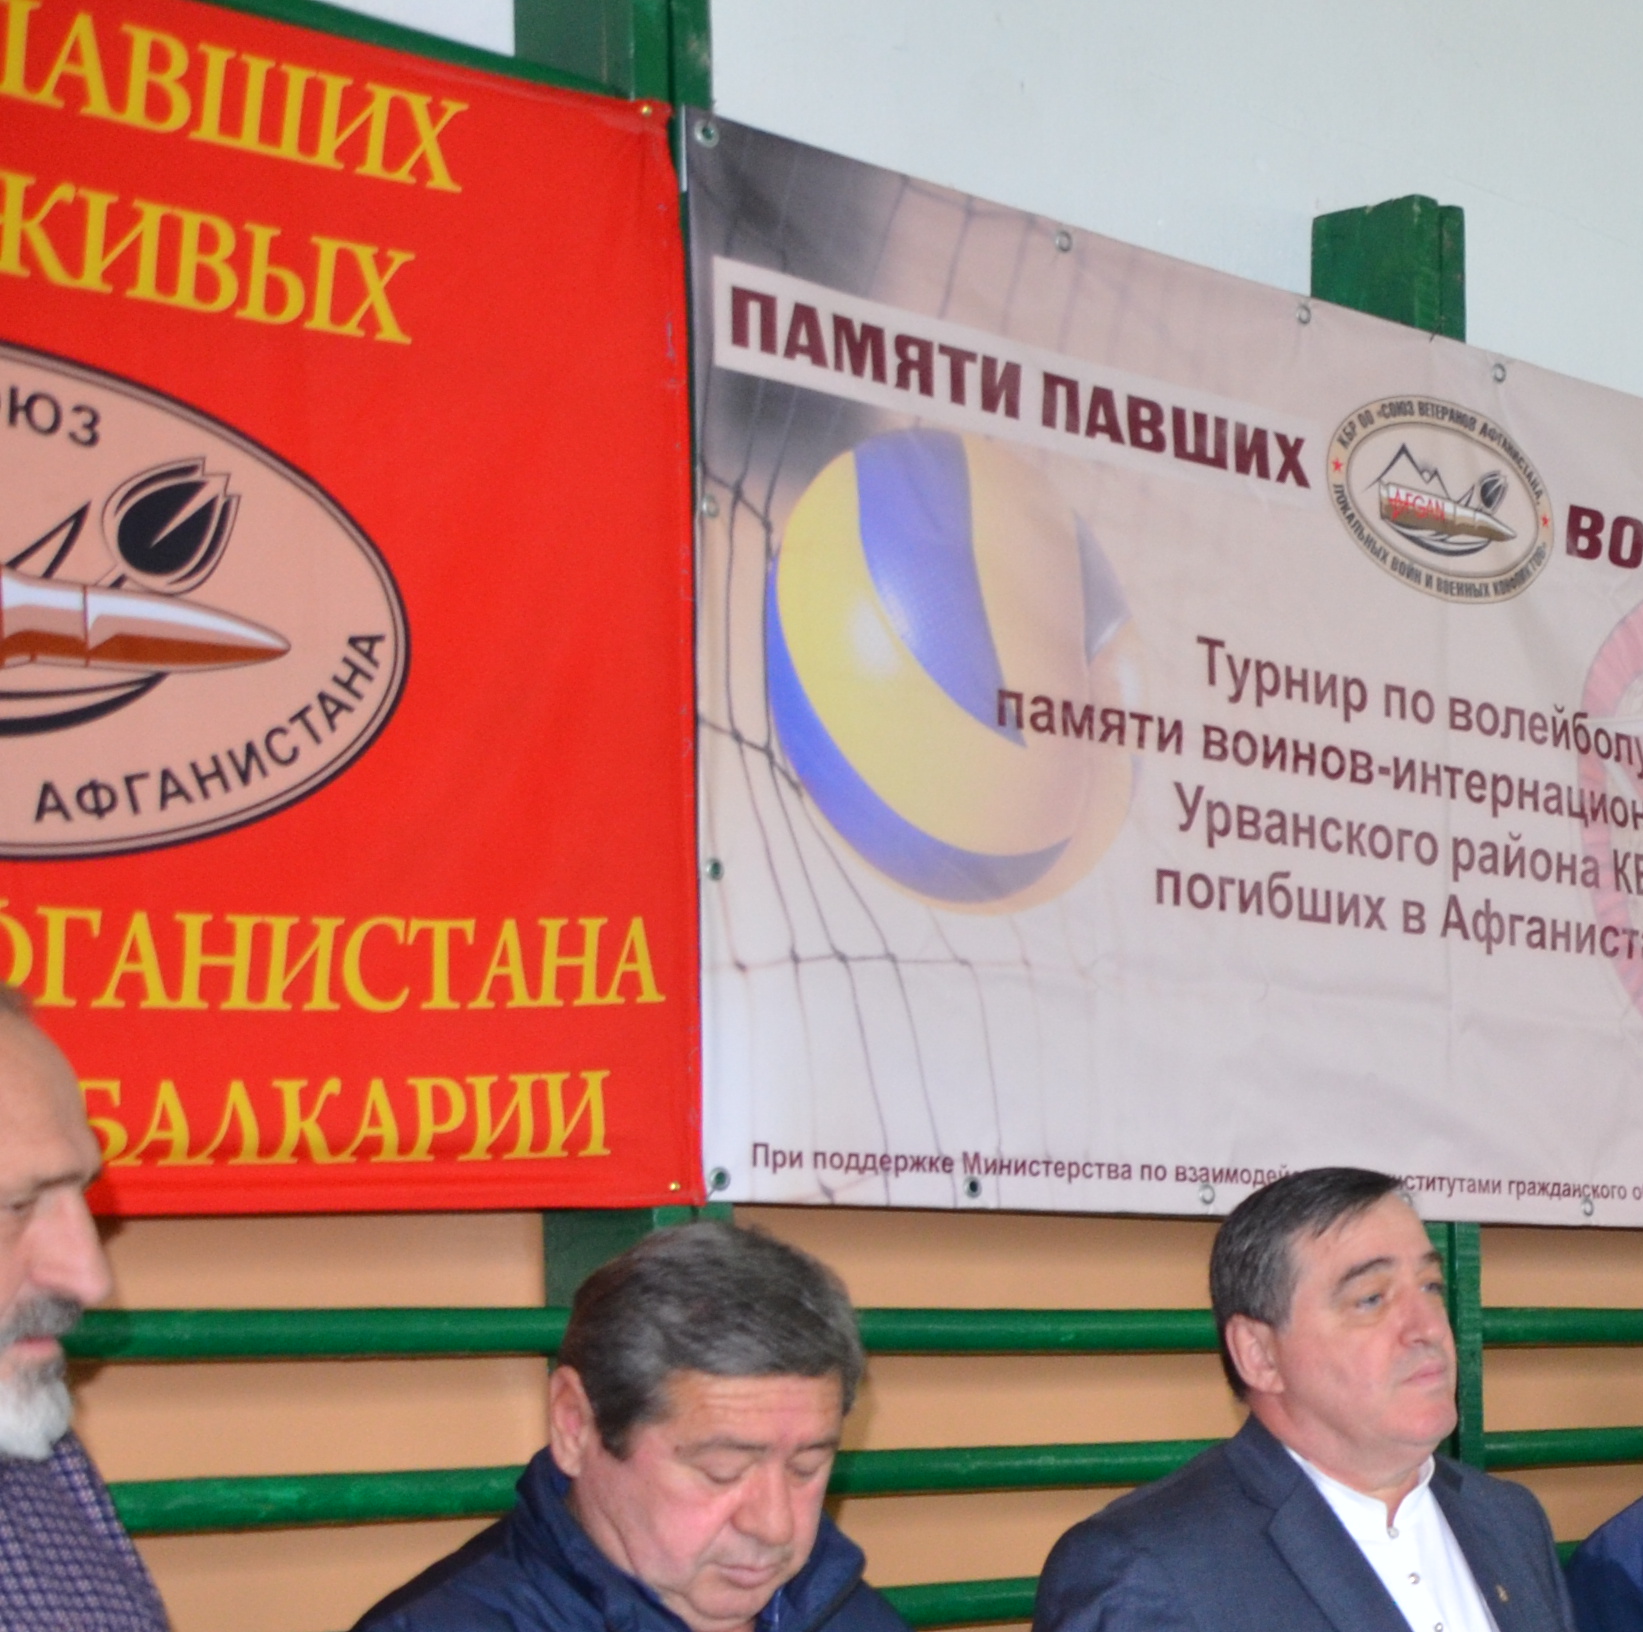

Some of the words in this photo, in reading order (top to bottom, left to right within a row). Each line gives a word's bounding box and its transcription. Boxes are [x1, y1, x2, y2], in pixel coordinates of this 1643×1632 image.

[0, 385, 102, 449] ЮЗ
[731, 285, 1022, 420] ПАМЯТИ
[1041, 371, 1311, 489] ПАВШИХ
[1333, 484, 1389, 564] ЛОКАЛЬНЫХ
[1388, 488, 1446, 522] AFGAN
[1196, 635, 1369, 722] Турнир
[1384, 683, 1435, 724] по
[33, 631, 386, 824] АФГАНИСТАНА
[996, 688, 1184, 756] памяти
[1173, 780, 1439, 867] Урванского
[1451, 833, 1601, 890] района
[1155, 867, 1388, 933] погибших
[1402, 899, 1427, 936] в
[752, 1142, 804, 1174] При
[813, 1151, 955, 1179] поддержке
[962, 1151, 1132, 1185] Министерства
[1140, 1163, 1168, 1183] по
[1508, 1179, 1628, 1201] гражданского
